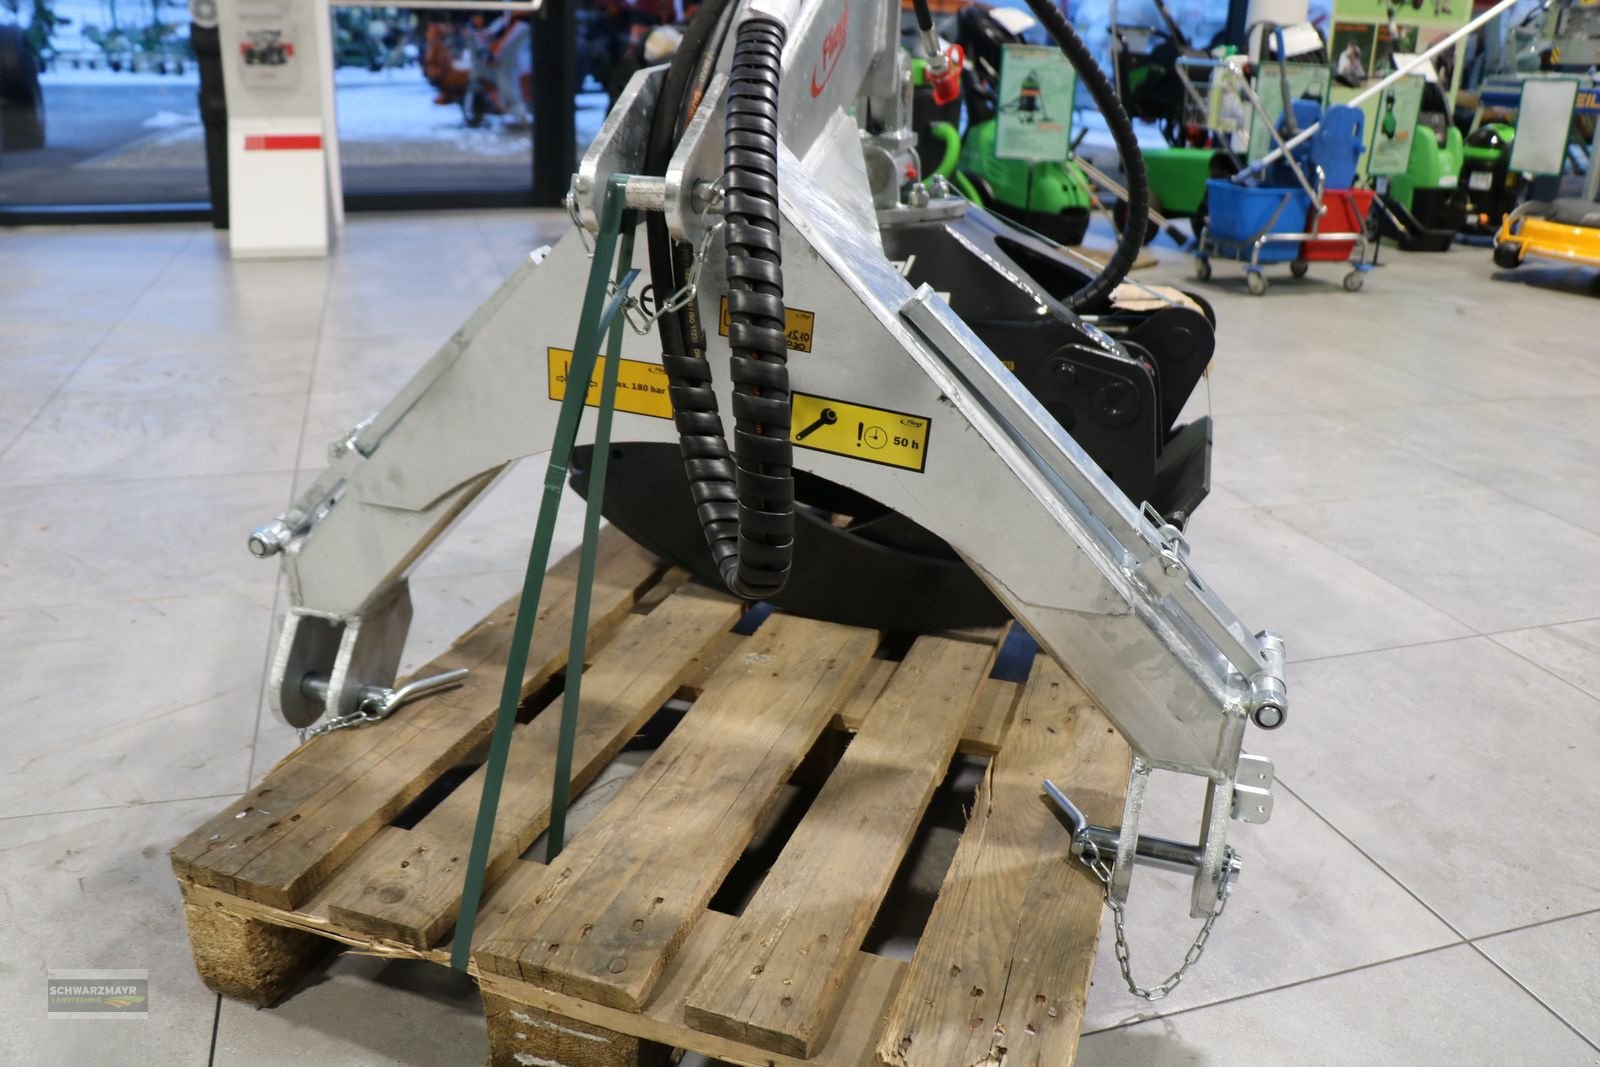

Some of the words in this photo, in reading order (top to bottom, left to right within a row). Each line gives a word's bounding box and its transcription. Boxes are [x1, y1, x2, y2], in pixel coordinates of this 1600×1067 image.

[616, 381, 630, 390] ax.
[631, 382, 648, 392] 180
[650, 385, 666, 395] bar
[893, 435, 909, 448] 50
[911, 439, 919, 450] h
